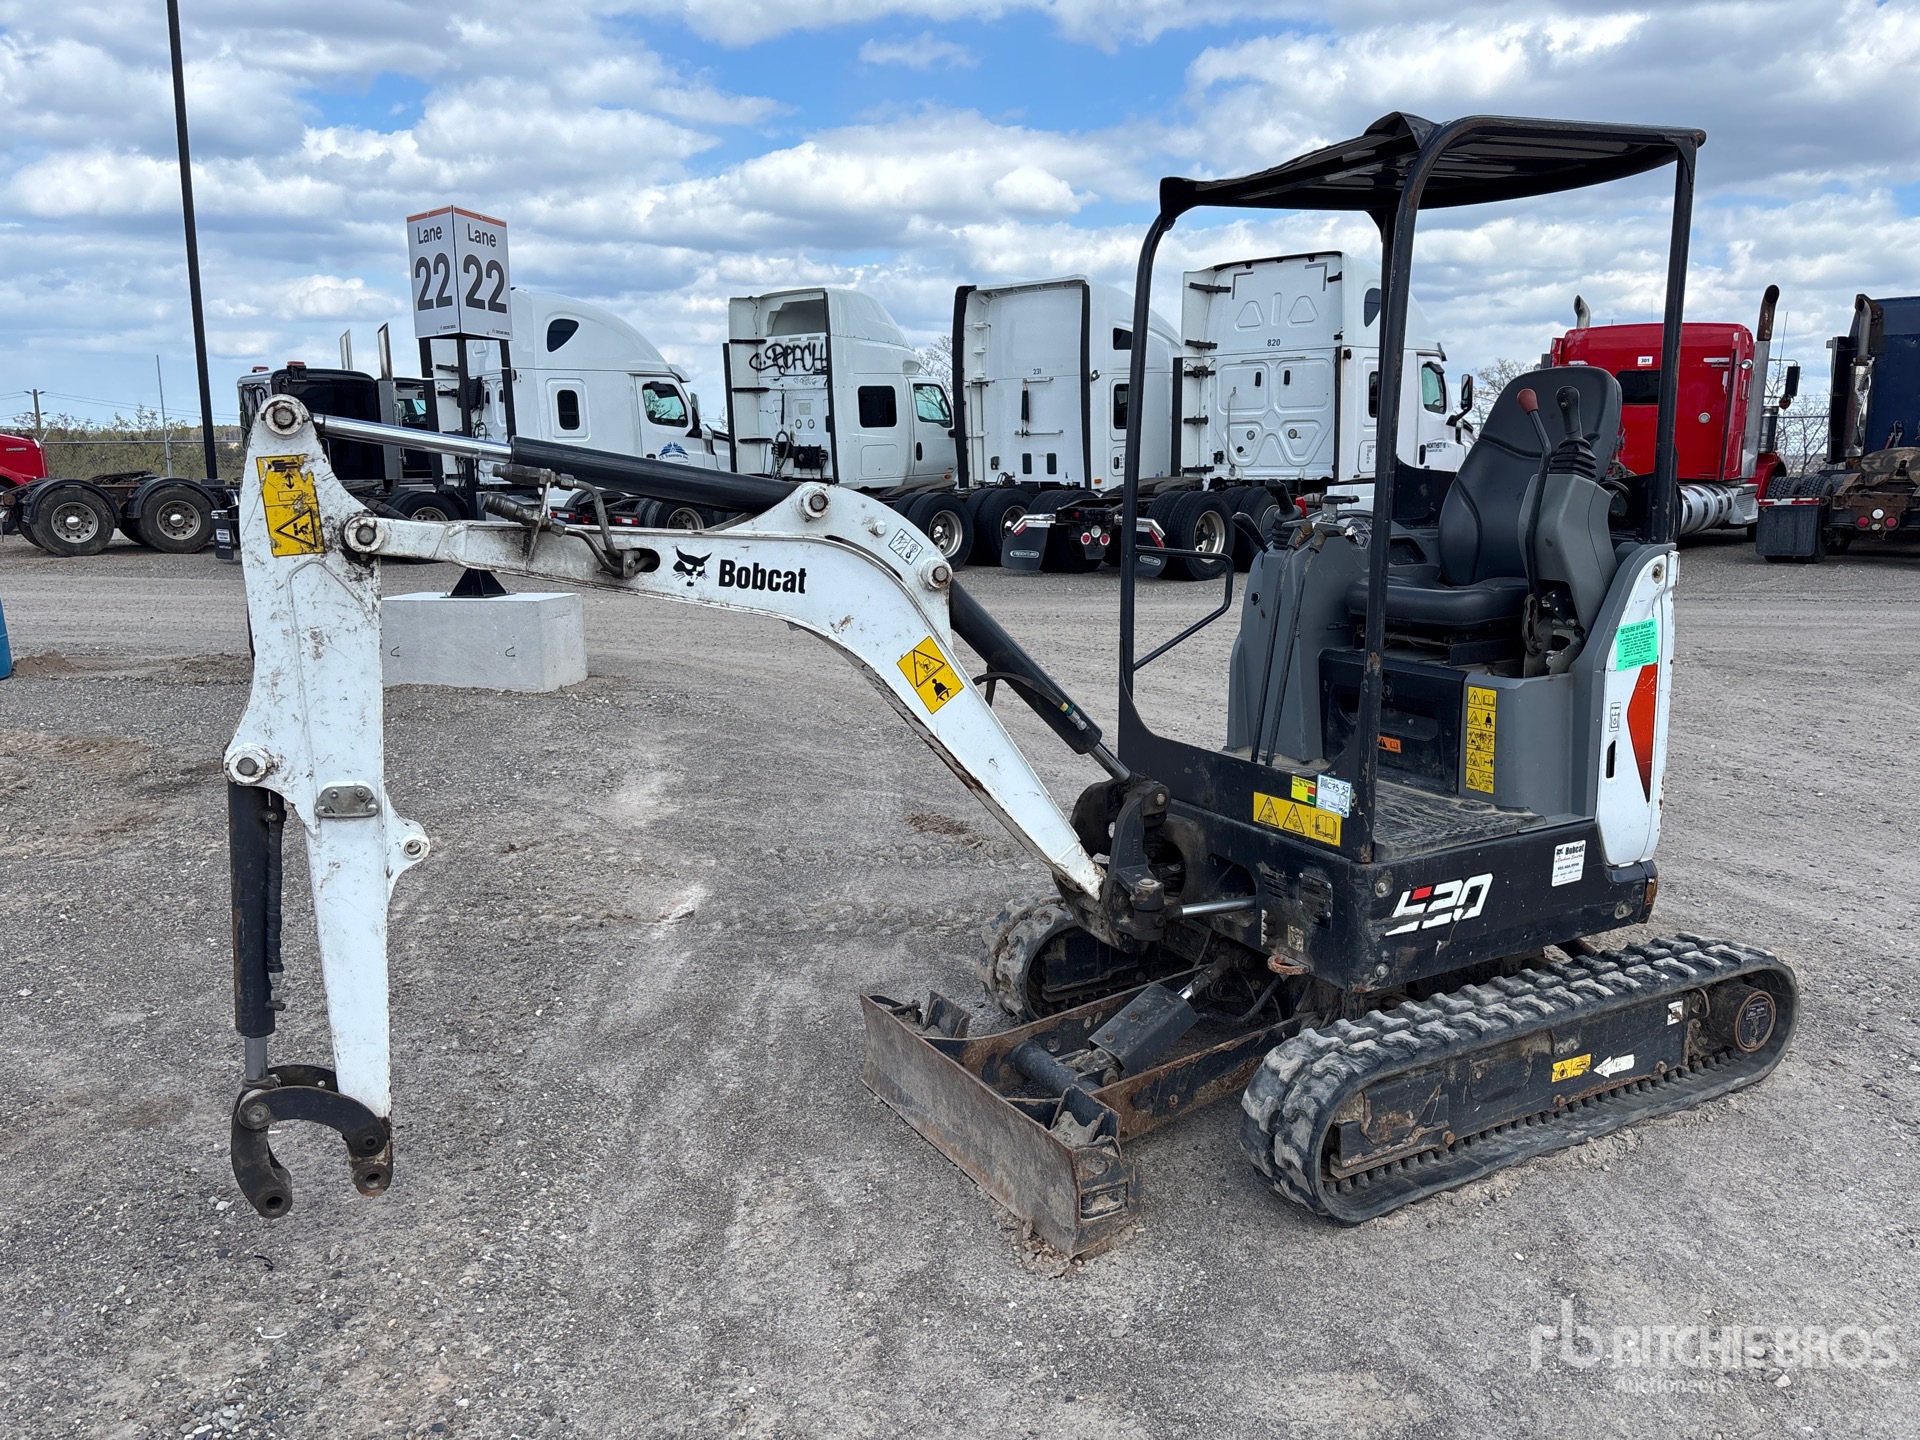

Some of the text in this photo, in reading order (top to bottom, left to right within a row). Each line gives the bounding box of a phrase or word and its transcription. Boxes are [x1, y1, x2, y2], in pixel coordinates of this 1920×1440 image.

[417, 225, 442, 244] Lane
[467, 223, 496, 247] Lane
[415, 253, 453, 311] 22
[463, 254, 507, 314] 22
[1267, 338, 1281, 347] 820
[718, 559, 807, 594] Bobcat
[1565, 844, 1584, 855] Bobcat
[1385, 873, 1493, 937] E20
